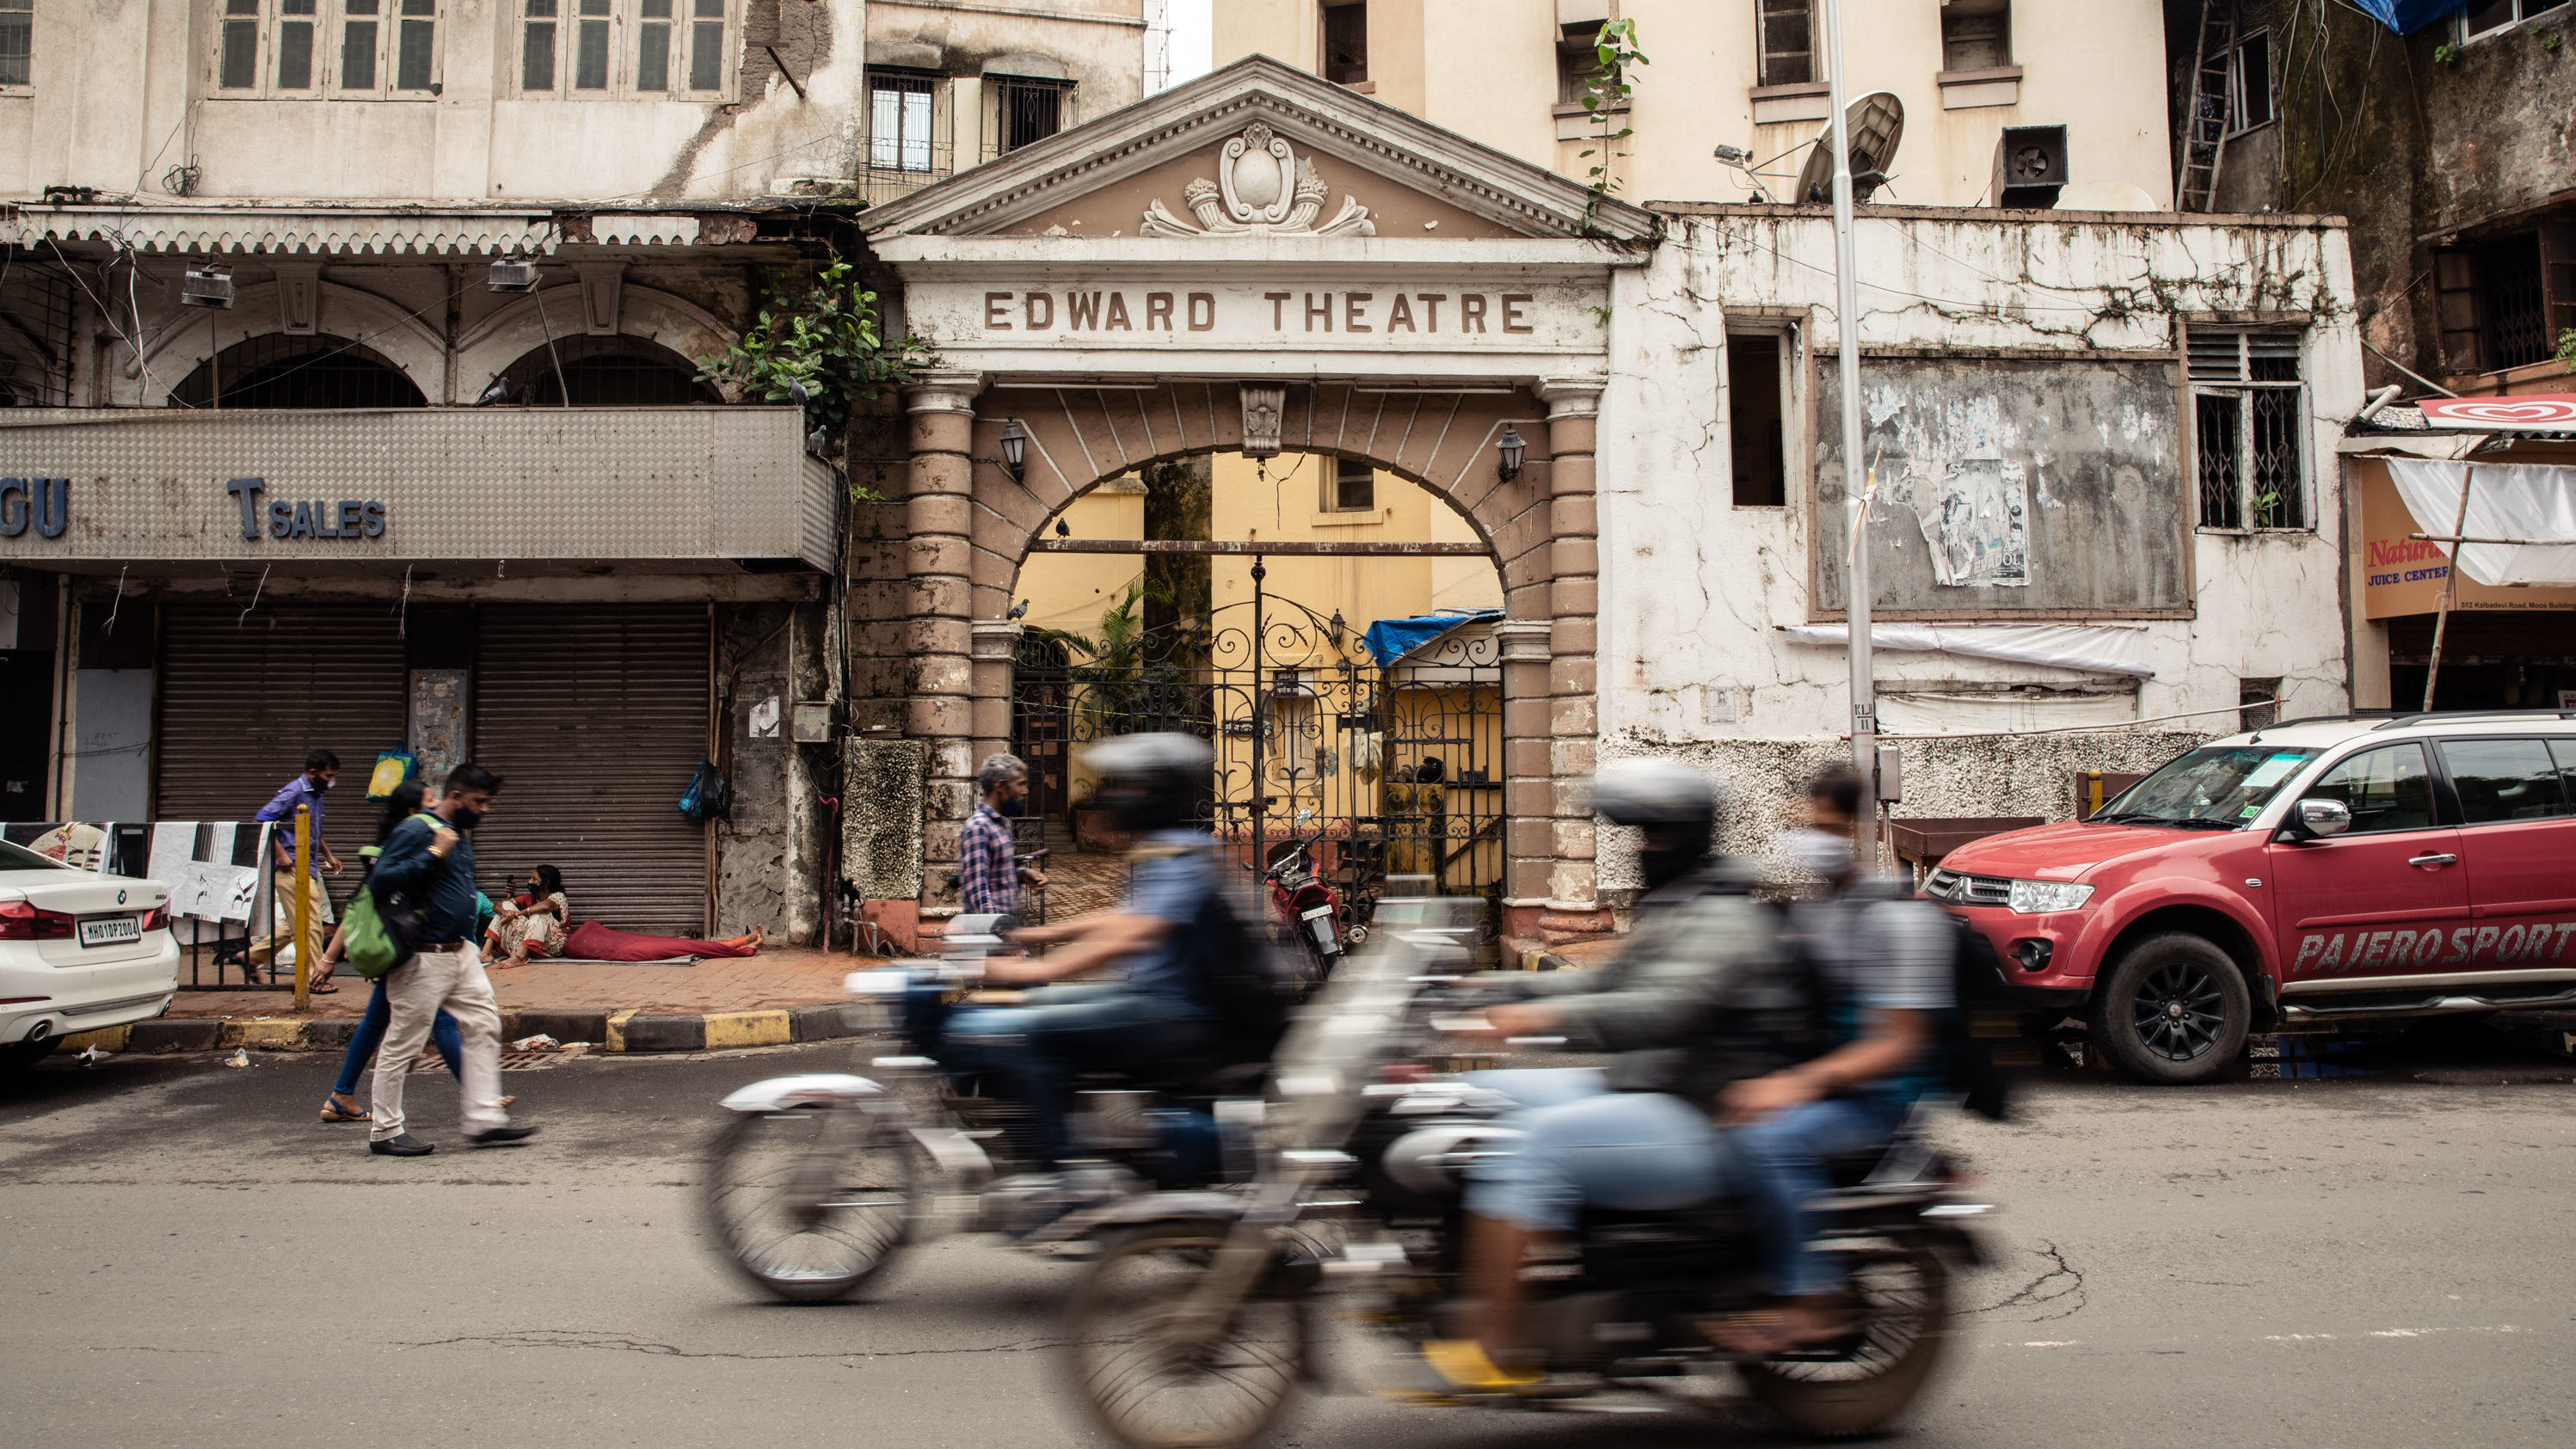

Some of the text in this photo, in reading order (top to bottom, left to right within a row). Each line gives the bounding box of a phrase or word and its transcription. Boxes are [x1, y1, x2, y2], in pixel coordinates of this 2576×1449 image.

[984, 292, 1534, 335] EDWARD THEATRE
[2368, 537, 2446, 568] Natura
[2368, 573, 2401, 586] JUICE
[1860, 719, 1869, 730] 11
[88, 921, 138, 940] MH01DP2004
[2292, 922, 2576, 973] PAJERO SPORT
